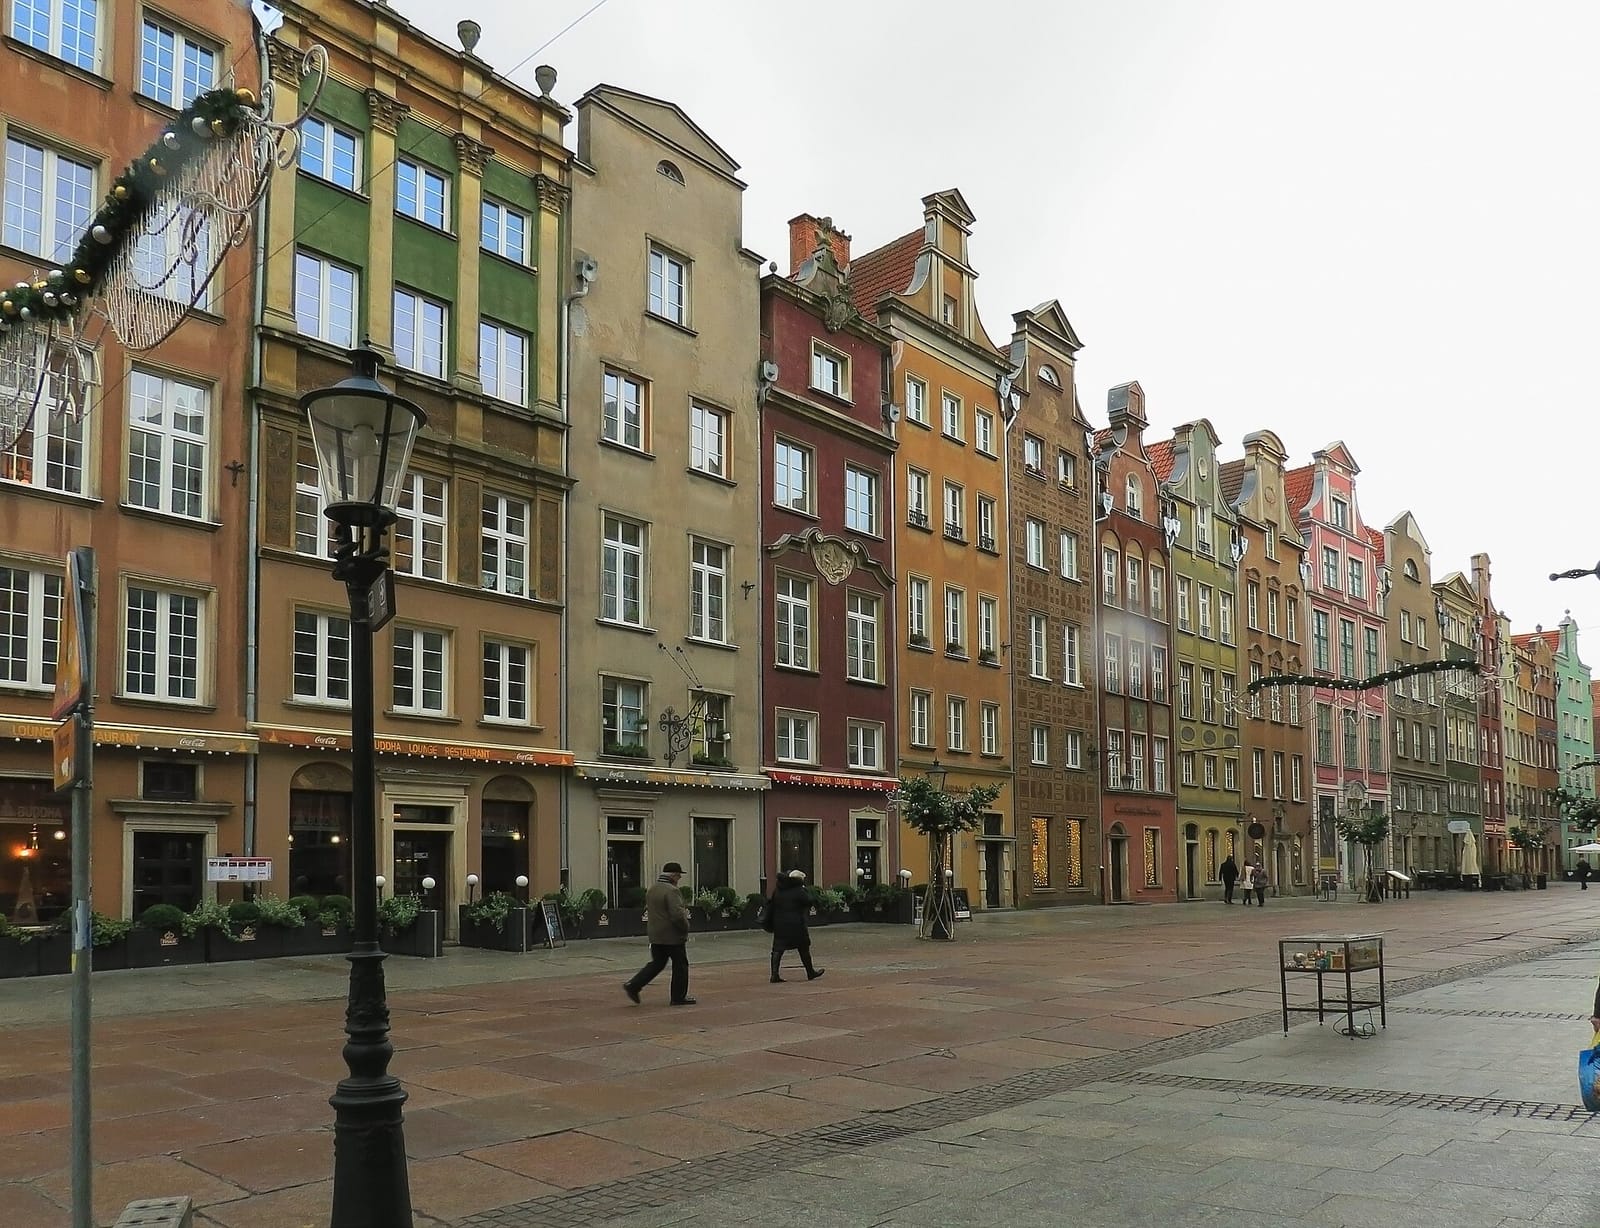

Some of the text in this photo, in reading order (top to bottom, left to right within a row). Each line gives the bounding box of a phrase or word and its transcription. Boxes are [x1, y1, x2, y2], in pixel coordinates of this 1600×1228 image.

[92, 729, 140, 744] TAURANT
[374, 740, 491, 759] UDDHA LOUNGE RESTAURANT
[16, 805, 63, 818] BUDDHA
